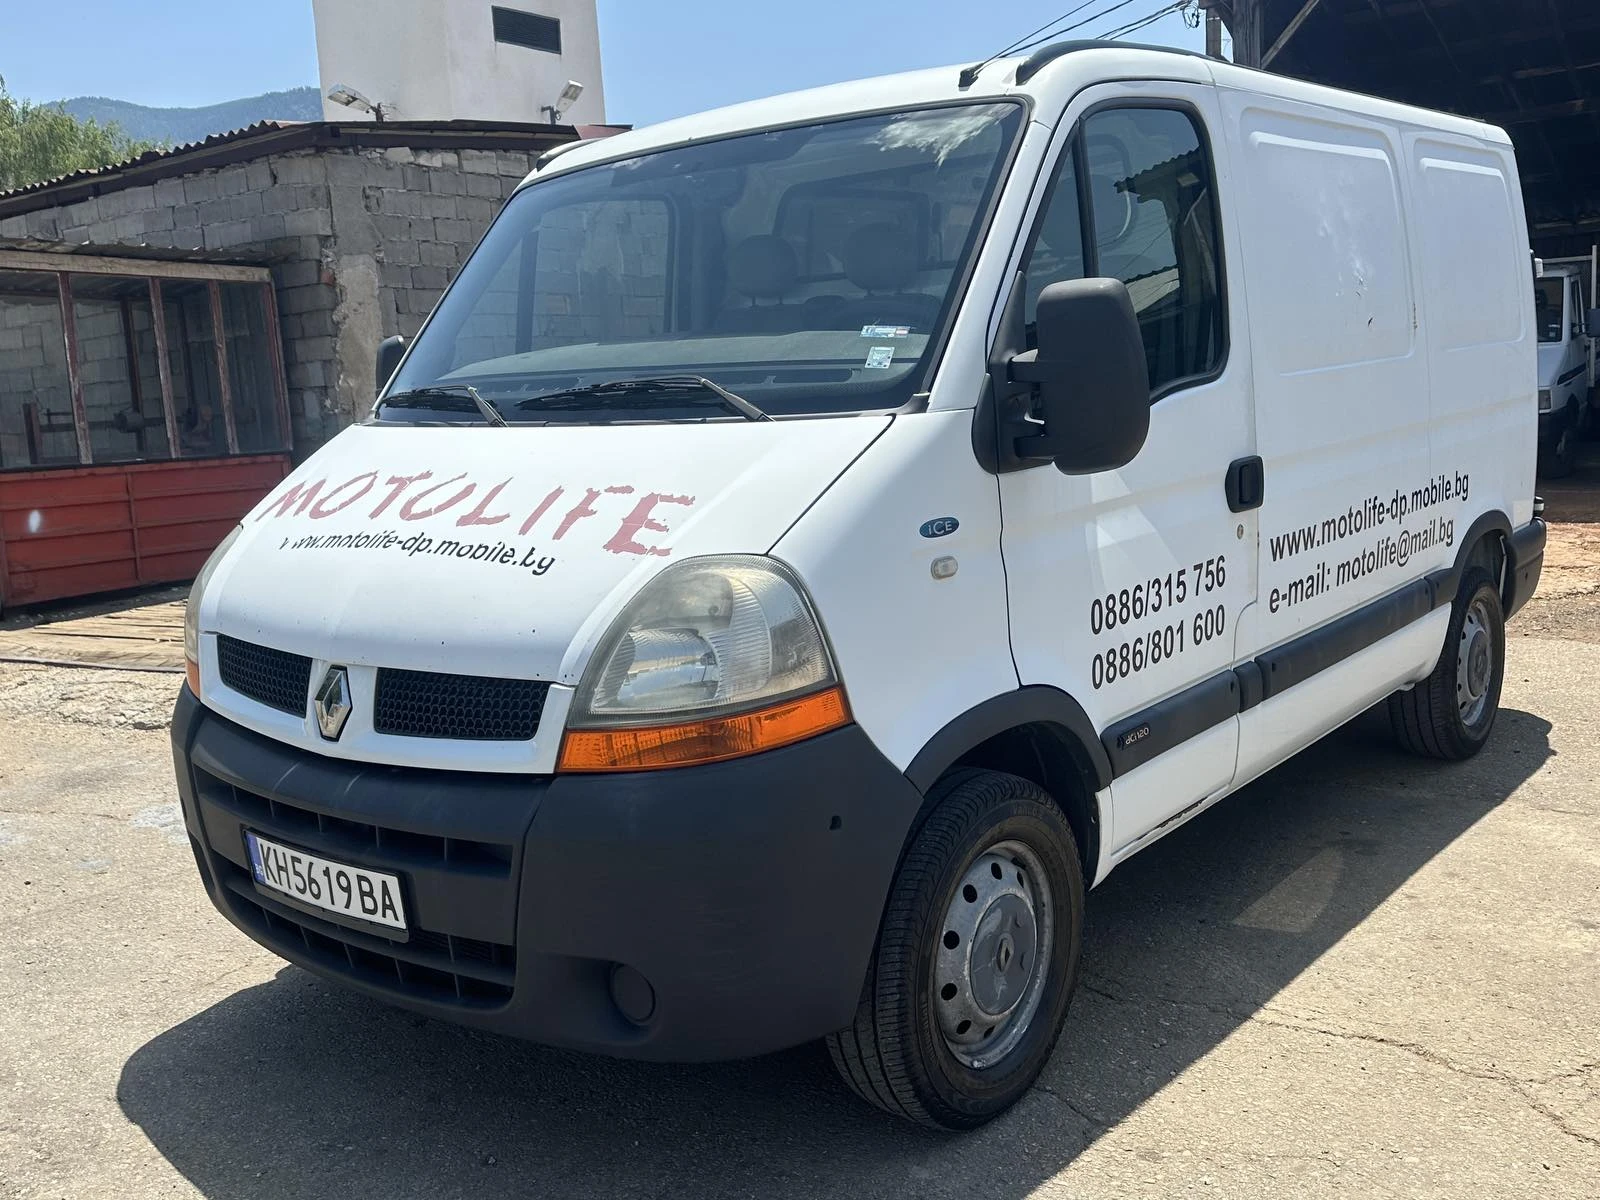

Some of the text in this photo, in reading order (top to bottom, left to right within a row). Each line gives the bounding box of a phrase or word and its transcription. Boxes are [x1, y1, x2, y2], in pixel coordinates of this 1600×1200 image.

[256, 470, 695, 557] MOTOLIFE
[1269, 471, 1469, 561] www.motolife-dp.mobile.bg
[1090, 555, 1226, 635] 0886/315 756
[1269, 518, 1455, 614] e-mail: motolife@mail.bg
[1091, 604, 1225, 690] 0886/801 600
[260, 843, 399, 921] KH5619BA
